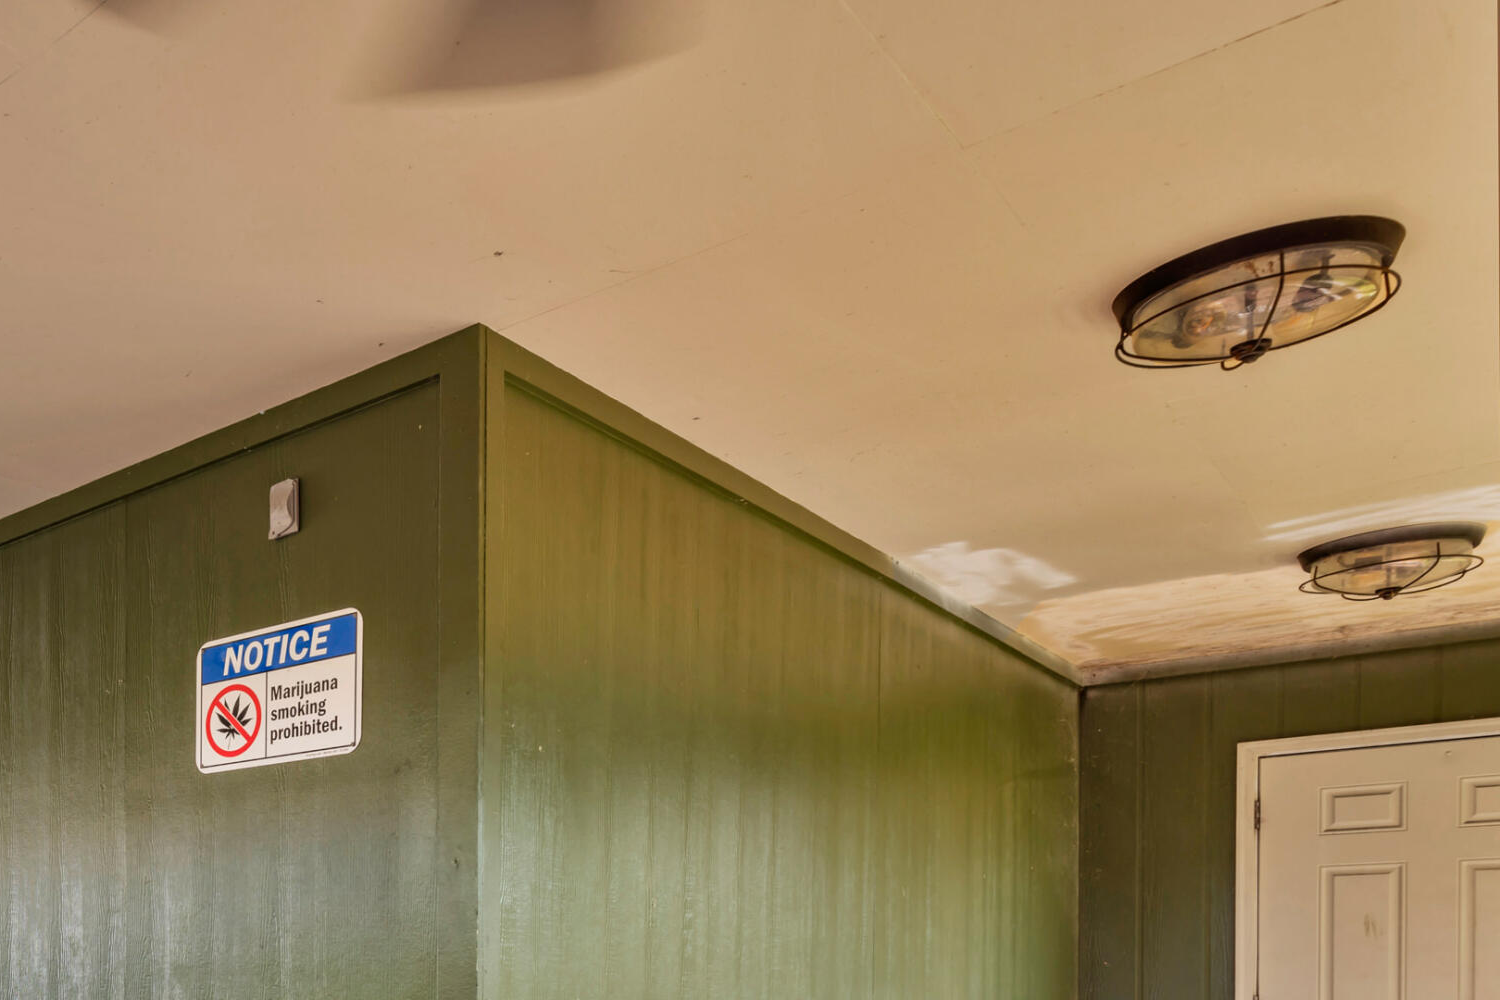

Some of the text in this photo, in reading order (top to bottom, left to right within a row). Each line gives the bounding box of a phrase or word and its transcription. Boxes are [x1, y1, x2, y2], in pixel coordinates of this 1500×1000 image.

[223, 624, 331, 676] NOTICE
[270, 677, 338, 701] Marijuana
[270, 699, 327, 721] smoking
[270, 716, 343, 744] prohibited.
